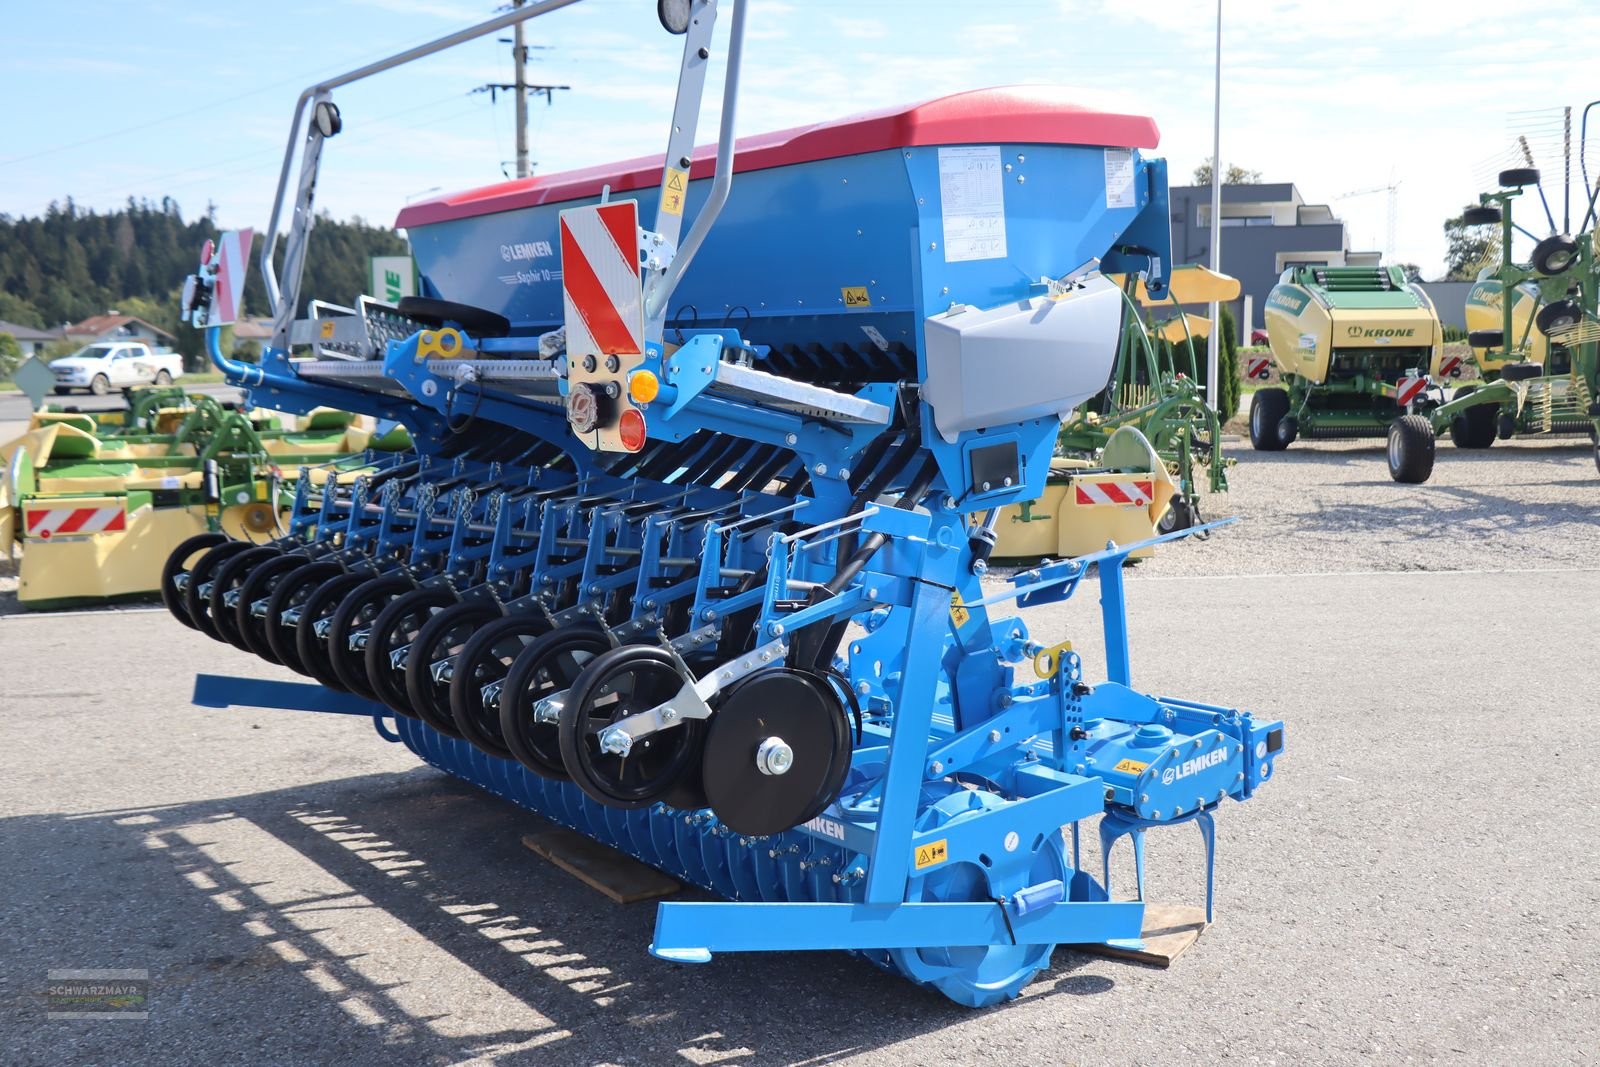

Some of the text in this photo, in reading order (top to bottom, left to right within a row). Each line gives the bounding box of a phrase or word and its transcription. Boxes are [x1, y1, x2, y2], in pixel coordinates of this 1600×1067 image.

[509, 241, 553, 261] LEMKEN
[516, 269, 551, 286] Saphir 10
[1364, 328, 1416, 338] KRONE
[1175, 746, 1228, 780] LEMKEN
[801, 816, 845, 841] MKEN
